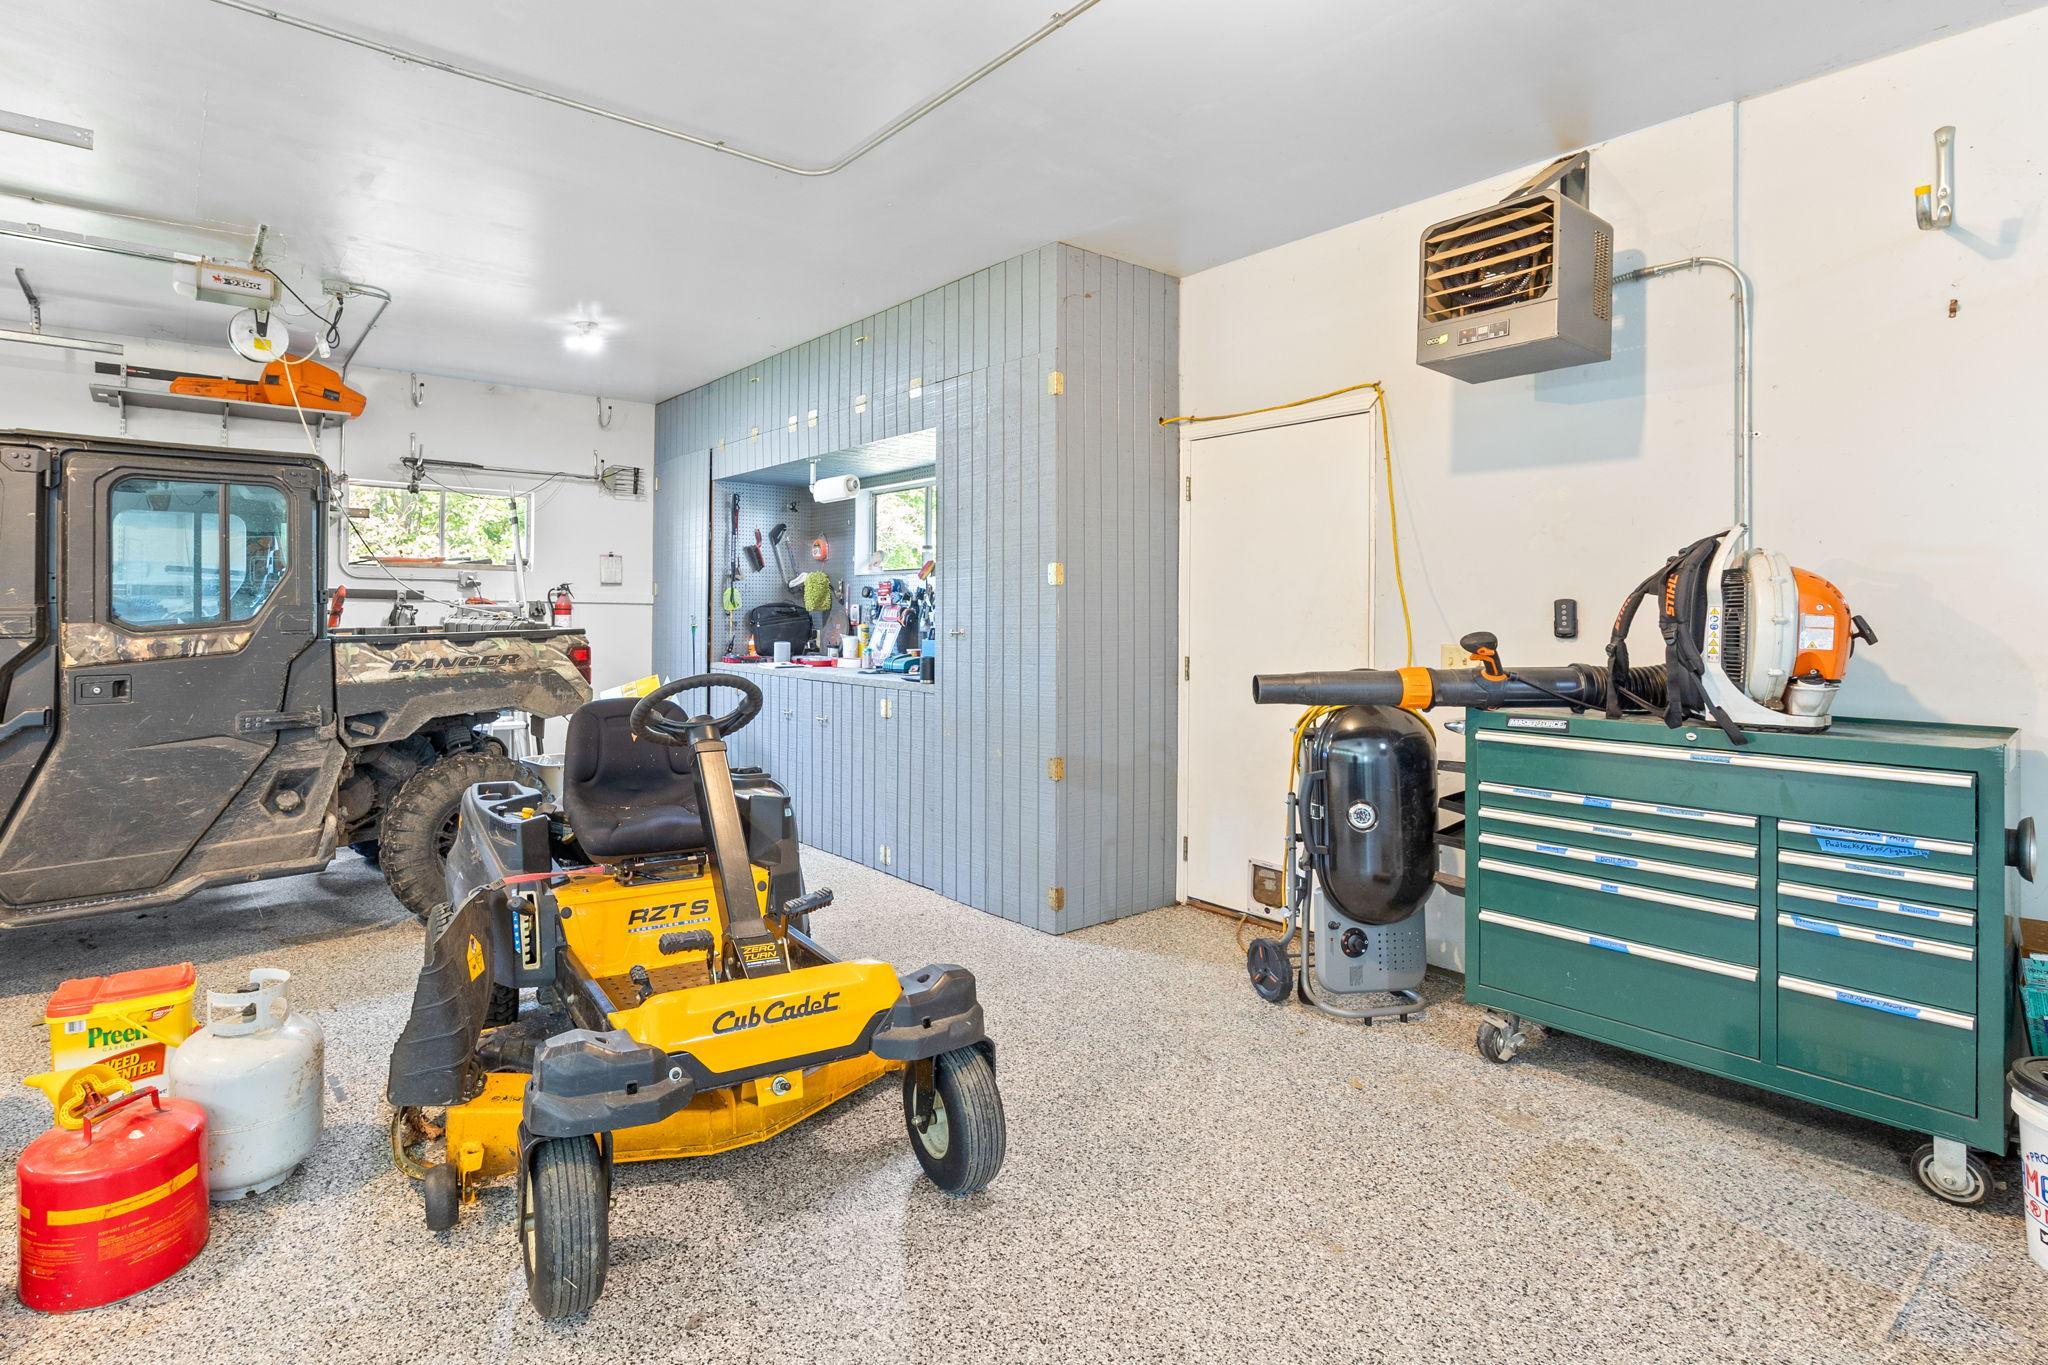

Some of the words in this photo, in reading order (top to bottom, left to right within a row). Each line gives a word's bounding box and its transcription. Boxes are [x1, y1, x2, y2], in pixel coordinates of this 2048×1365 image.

[1666, 573, 1679, 617] STIHL
[389, 653, 520, 672] RANGER
[628, 902, 687, 925] RZT
[690, 900, 709, 915] S
[742, 945, 776, 955] ZERO
[744, 951, 777, 961] TURN
[712, 1006, 761, 1034] Cub
[763, 992, 840, 1024] Cadet
[88, 1025, 149, 1048] Preen
